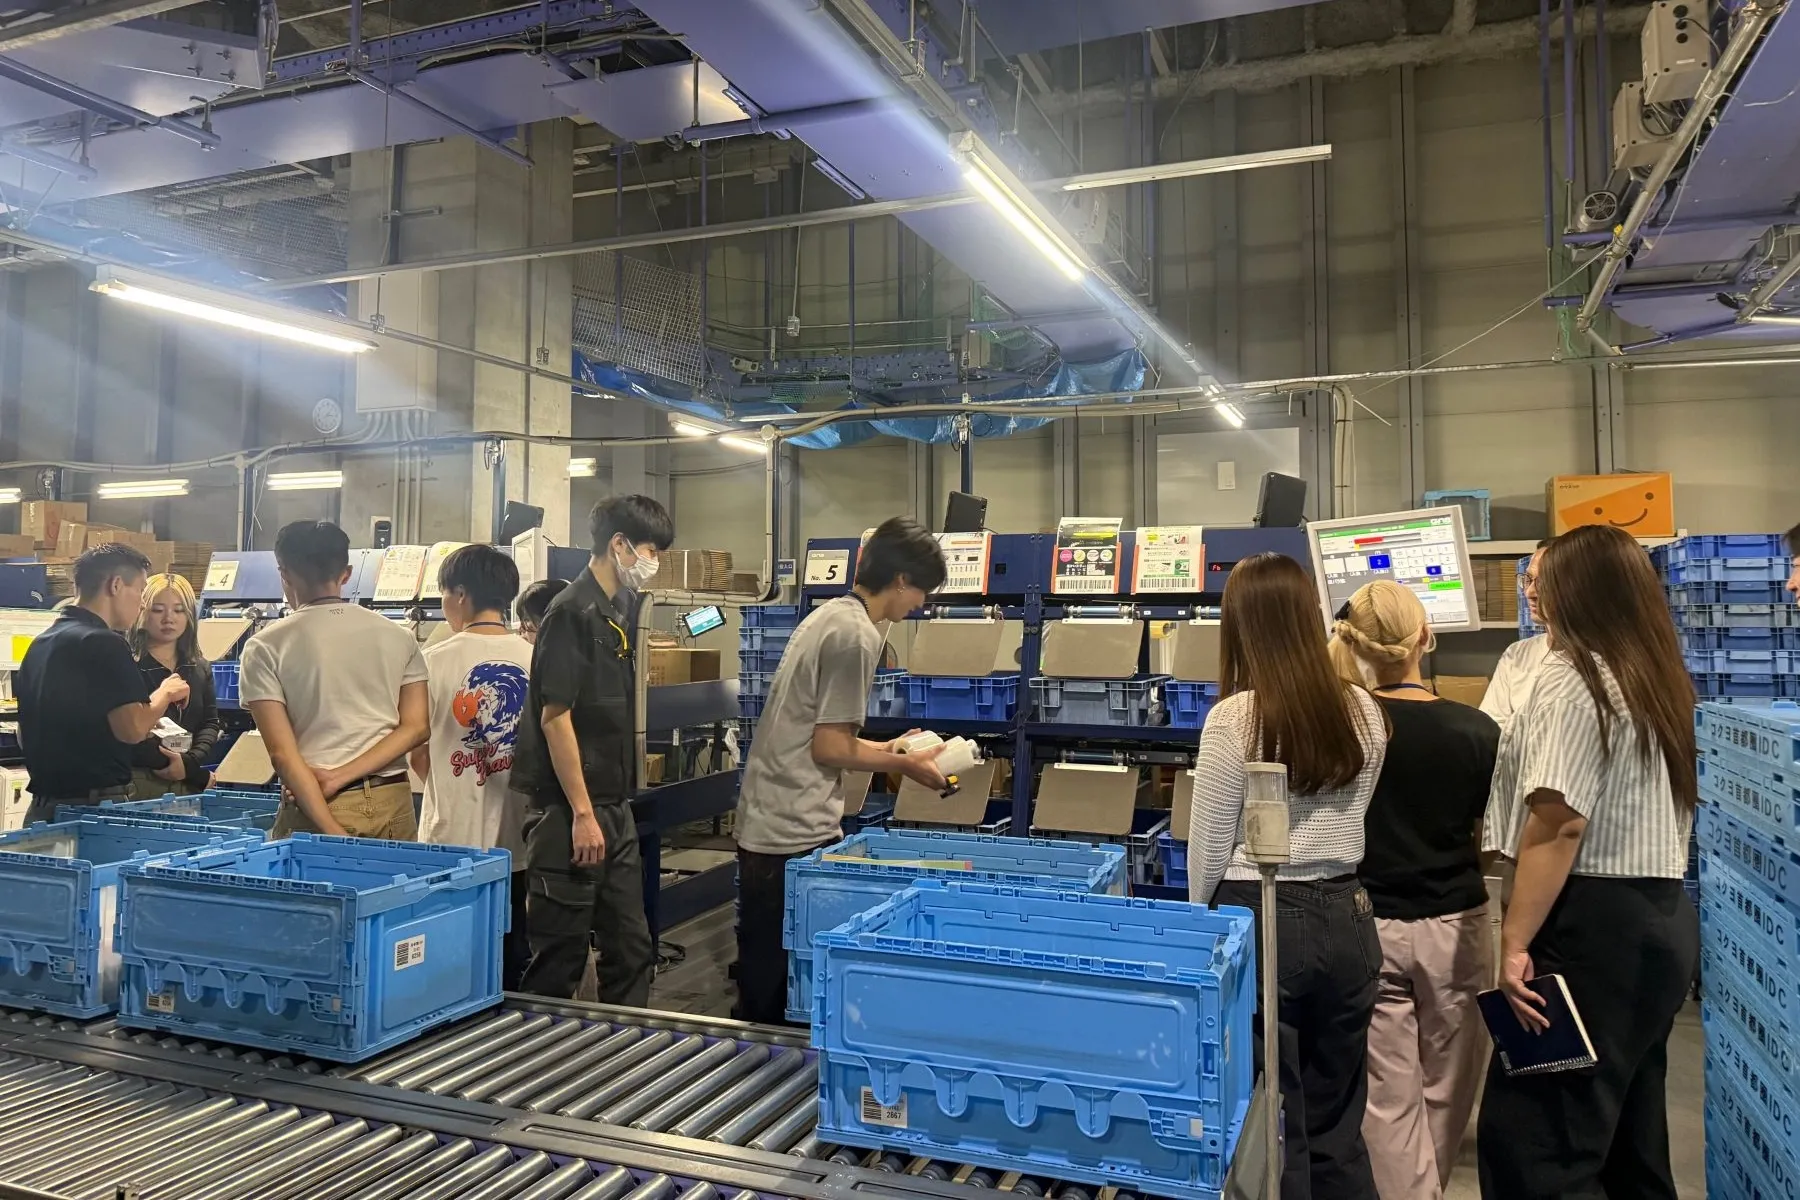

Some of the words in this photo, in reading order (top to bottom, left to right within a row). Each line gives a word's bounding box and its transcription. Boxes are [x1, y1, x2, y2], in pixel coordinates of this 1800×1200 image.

[219, 573, 229, 586] 4
[825, 564, 838, 580] 5
[1711, 723, 1780, 759] コクヨ首都圏IDC
[1713, 774, 1783, 823] コクヨ首都圏IDC
[1708, 821, 1787, 891] コクヨ首都圏IDC
[1716, 876, 1784, 945] コクヨ首都圏IDC
[1717, 928, 1787, 1009] コクヨ首都圏IDC
[1718, 981, 1790, 1072] コクヨ首都圏IDC
[1718, 1032, 1792, 1137] コクヨ首都圏IDC
